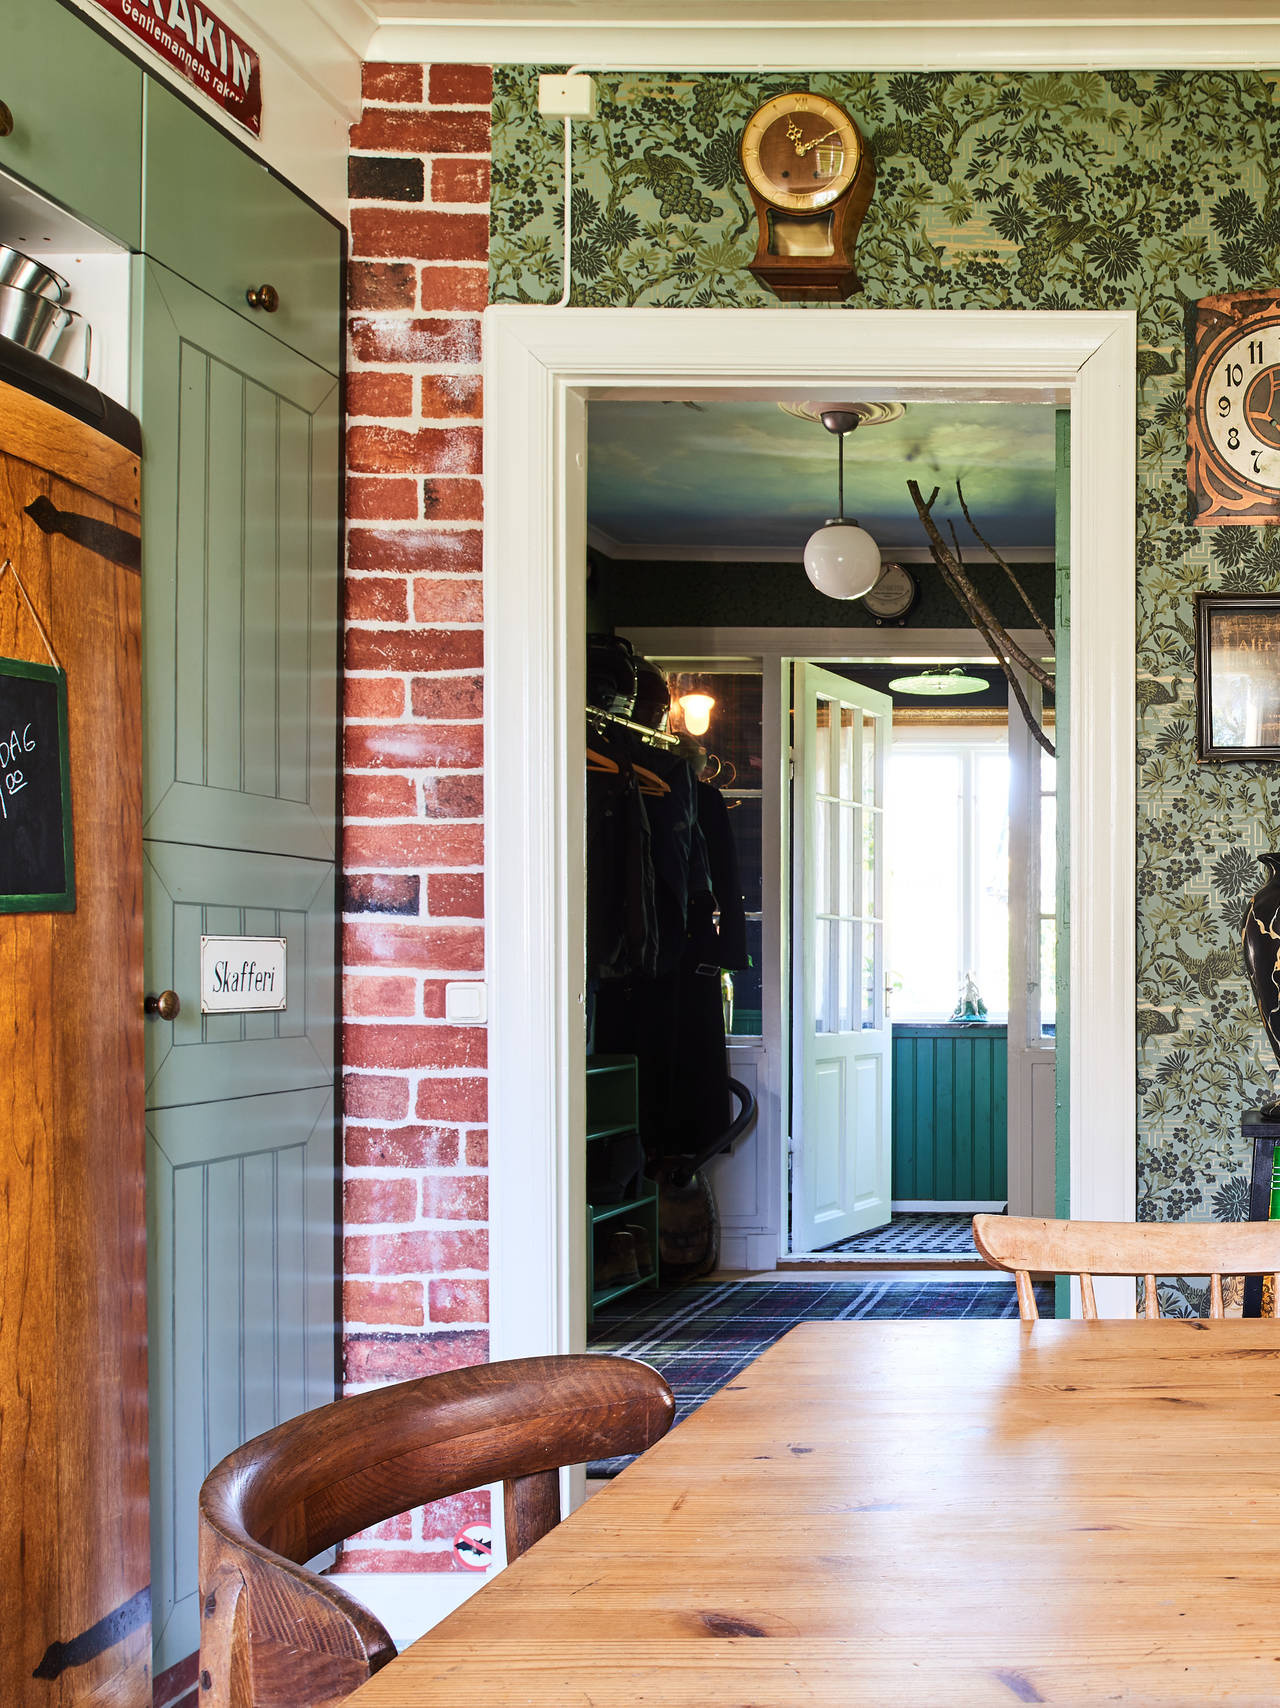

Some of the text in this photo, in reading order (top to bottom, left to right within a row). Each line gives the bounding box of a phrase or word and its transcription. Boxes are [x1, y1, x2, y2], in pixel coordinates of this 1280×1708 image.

[121, 0, 210, 82] Gentlemannens
[1248, 341, 1264, 364] 11
[1225, 363, 1244, 387] 10
[1218, 396, 1231, 418] 9
[1227, 427, 1240, 450] 8
[1250, 450, 1263, 474] 7
[212, 960, 276, 993] Skafferi
